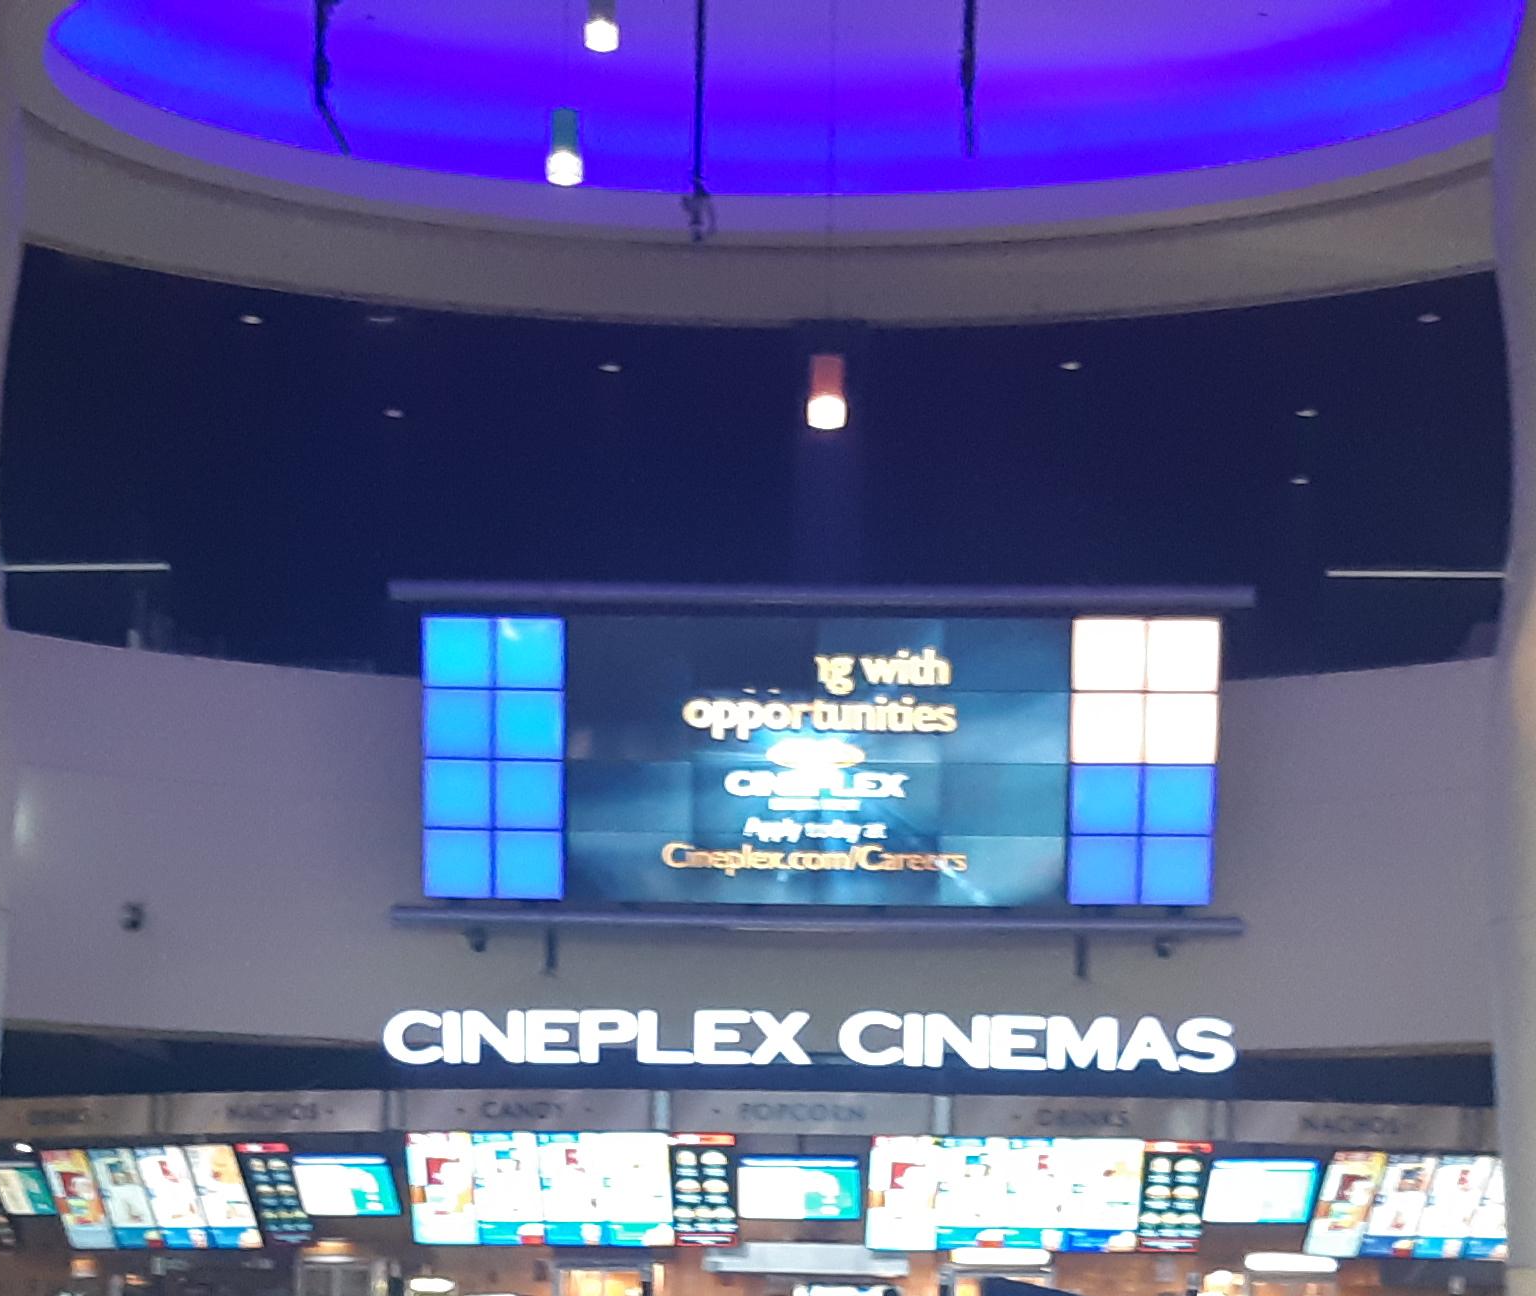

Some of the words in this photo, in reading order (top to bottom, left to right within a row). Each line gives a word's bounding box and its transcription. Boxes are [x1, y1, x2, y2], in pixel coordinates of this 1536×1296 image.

[860, 646, 954, 687] with
[681, 694, 960, 741] opportunities
[661, 841, 969, 877] Cineplex.com/Careers
[381, 1008, 813, 1068] CINEPLEX
[836, 1008, 1239, 1075] CINEMAS
